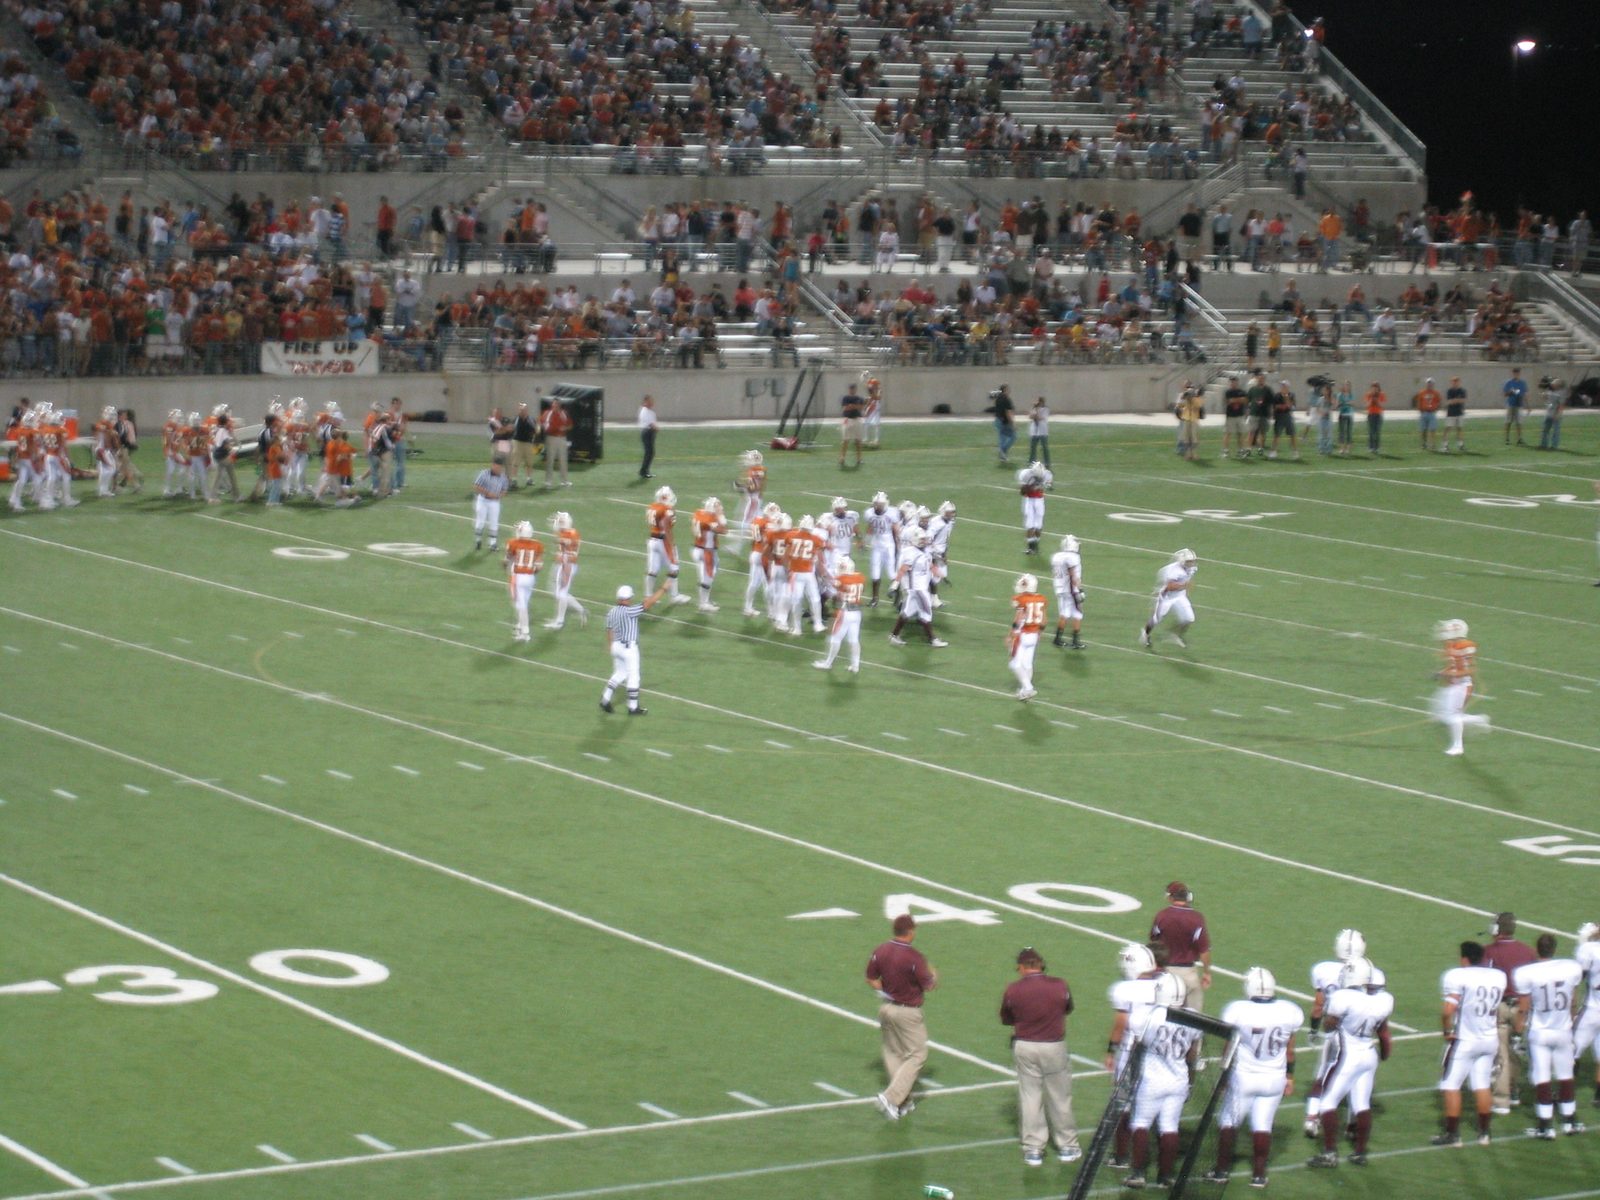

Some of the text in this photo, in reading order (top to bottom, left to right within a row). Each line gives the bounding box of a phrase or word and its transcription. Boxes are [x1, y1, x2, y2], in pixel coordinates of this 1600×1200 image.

[334, 341, 359, 354] UP
[516, 548, 535, 568] 11
[791, 538, 814, 559] 72
[1025, 602, 1044, 624] 15
[1475, 985, 1500, 1017] 32
[1540, 980, 1568, 1013] 15
[1251, 1026, 1280, 1059] 76
